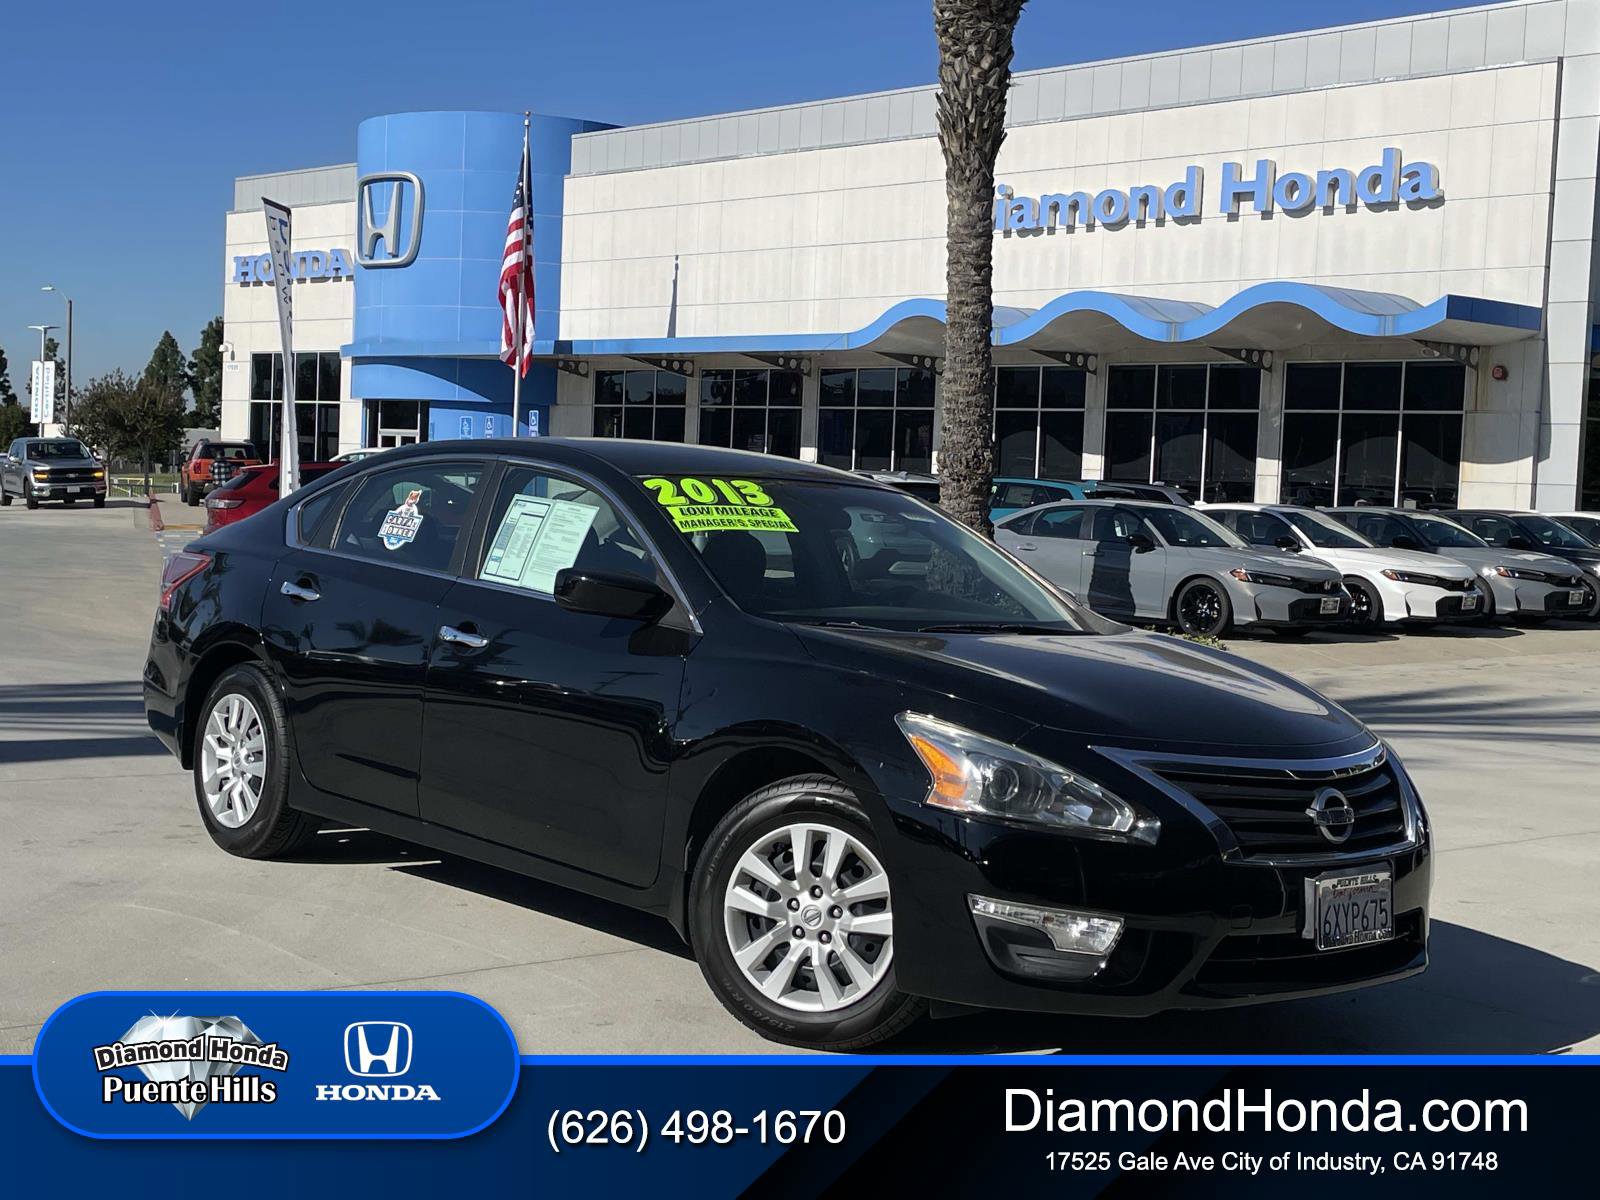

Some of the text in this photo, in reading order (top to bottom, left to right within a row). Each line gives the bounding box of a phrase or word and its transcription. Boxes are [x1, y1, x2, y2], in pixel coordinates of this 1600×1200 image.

[994, 147, 1442, 230] iamond Honda
[643, 478, 774, 506] 2013
[679, 506, 778, 518] LOW MILEAGE
[679, 518, 794, 530] MANAGER'S SPECIAL
[1323, 898, 1389, 936] 6XYP675
